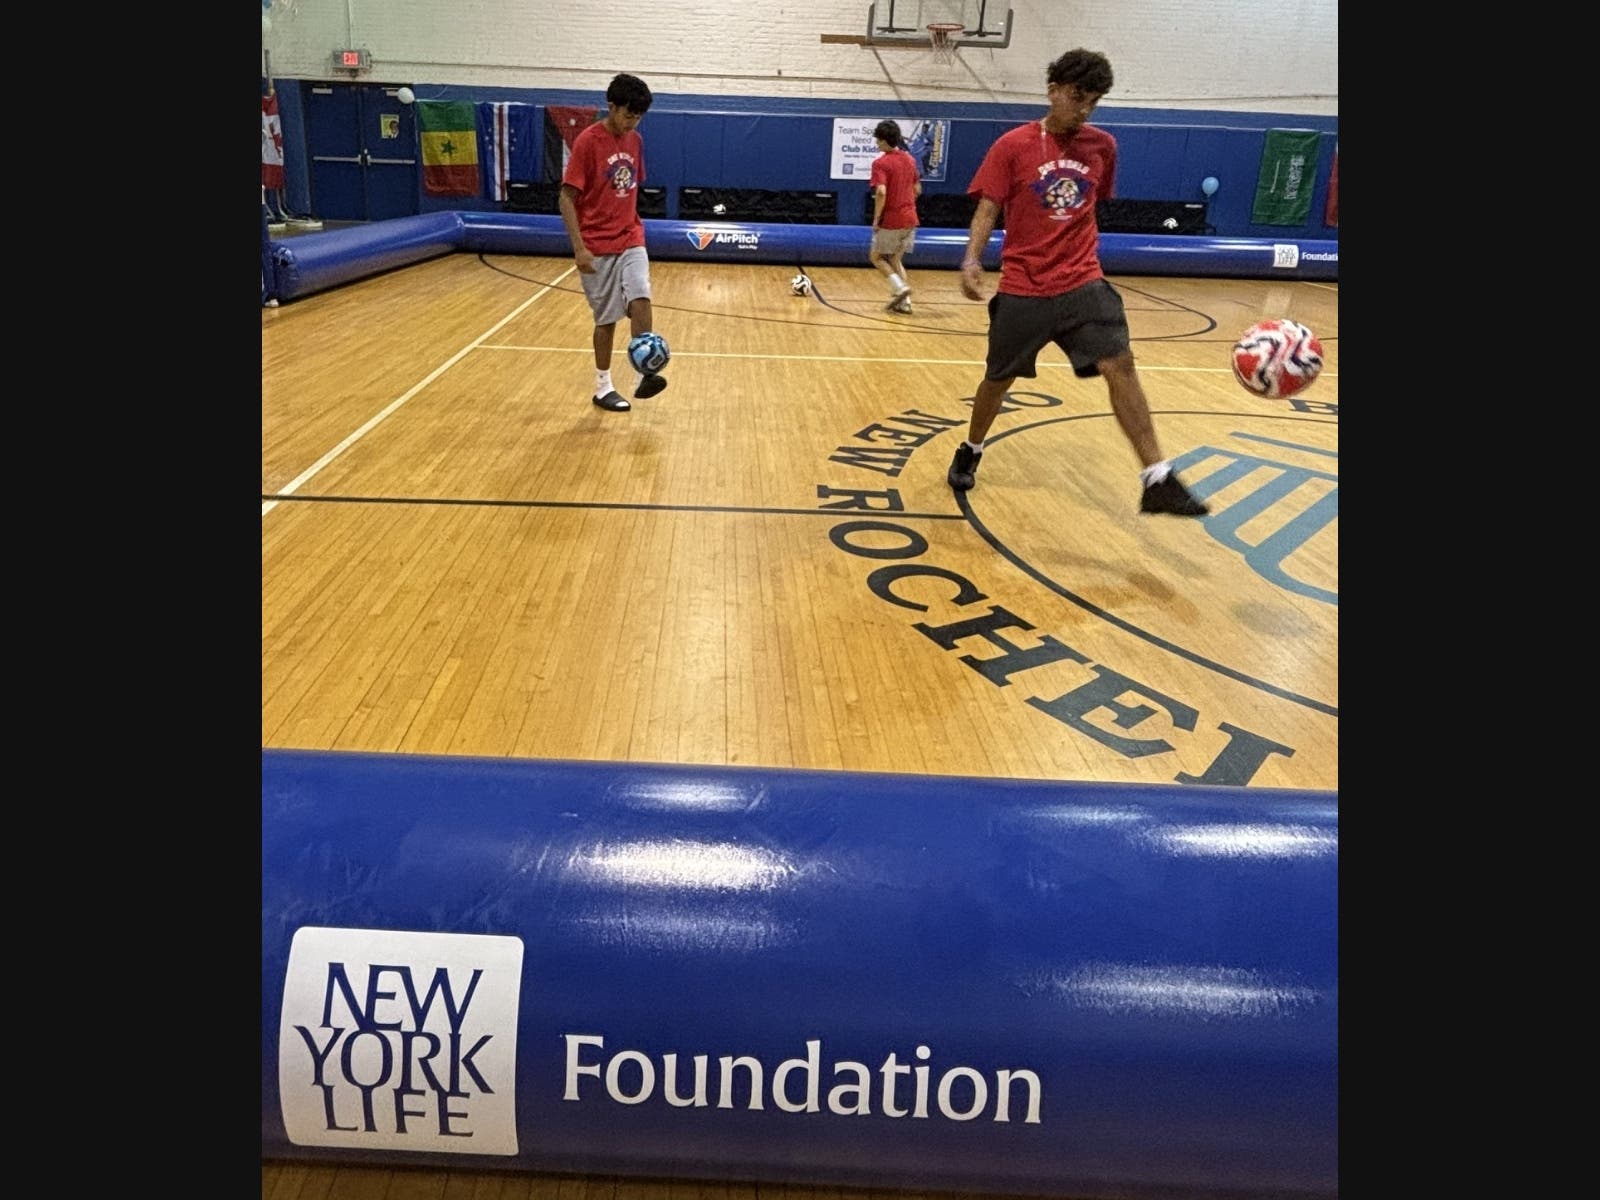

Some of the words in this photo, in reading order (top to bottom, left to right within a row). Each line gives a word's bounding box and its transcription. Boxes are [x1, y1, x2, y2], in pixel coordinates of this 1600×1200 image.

[839, 126, 860, 134] Team
[841, 145, 860, 153] Club
[852, 136, 872, 144] Need
[716, 233, 758, 244] AirPitch
[827, 409, 968, 478] NEW
[320, 962, 484, 1033] NEW
[293, 1025, 495, 1098] YORK
[562, 1033, 1041, 1124] Foundation
[322, 1085, 474, 1137] LIFE
